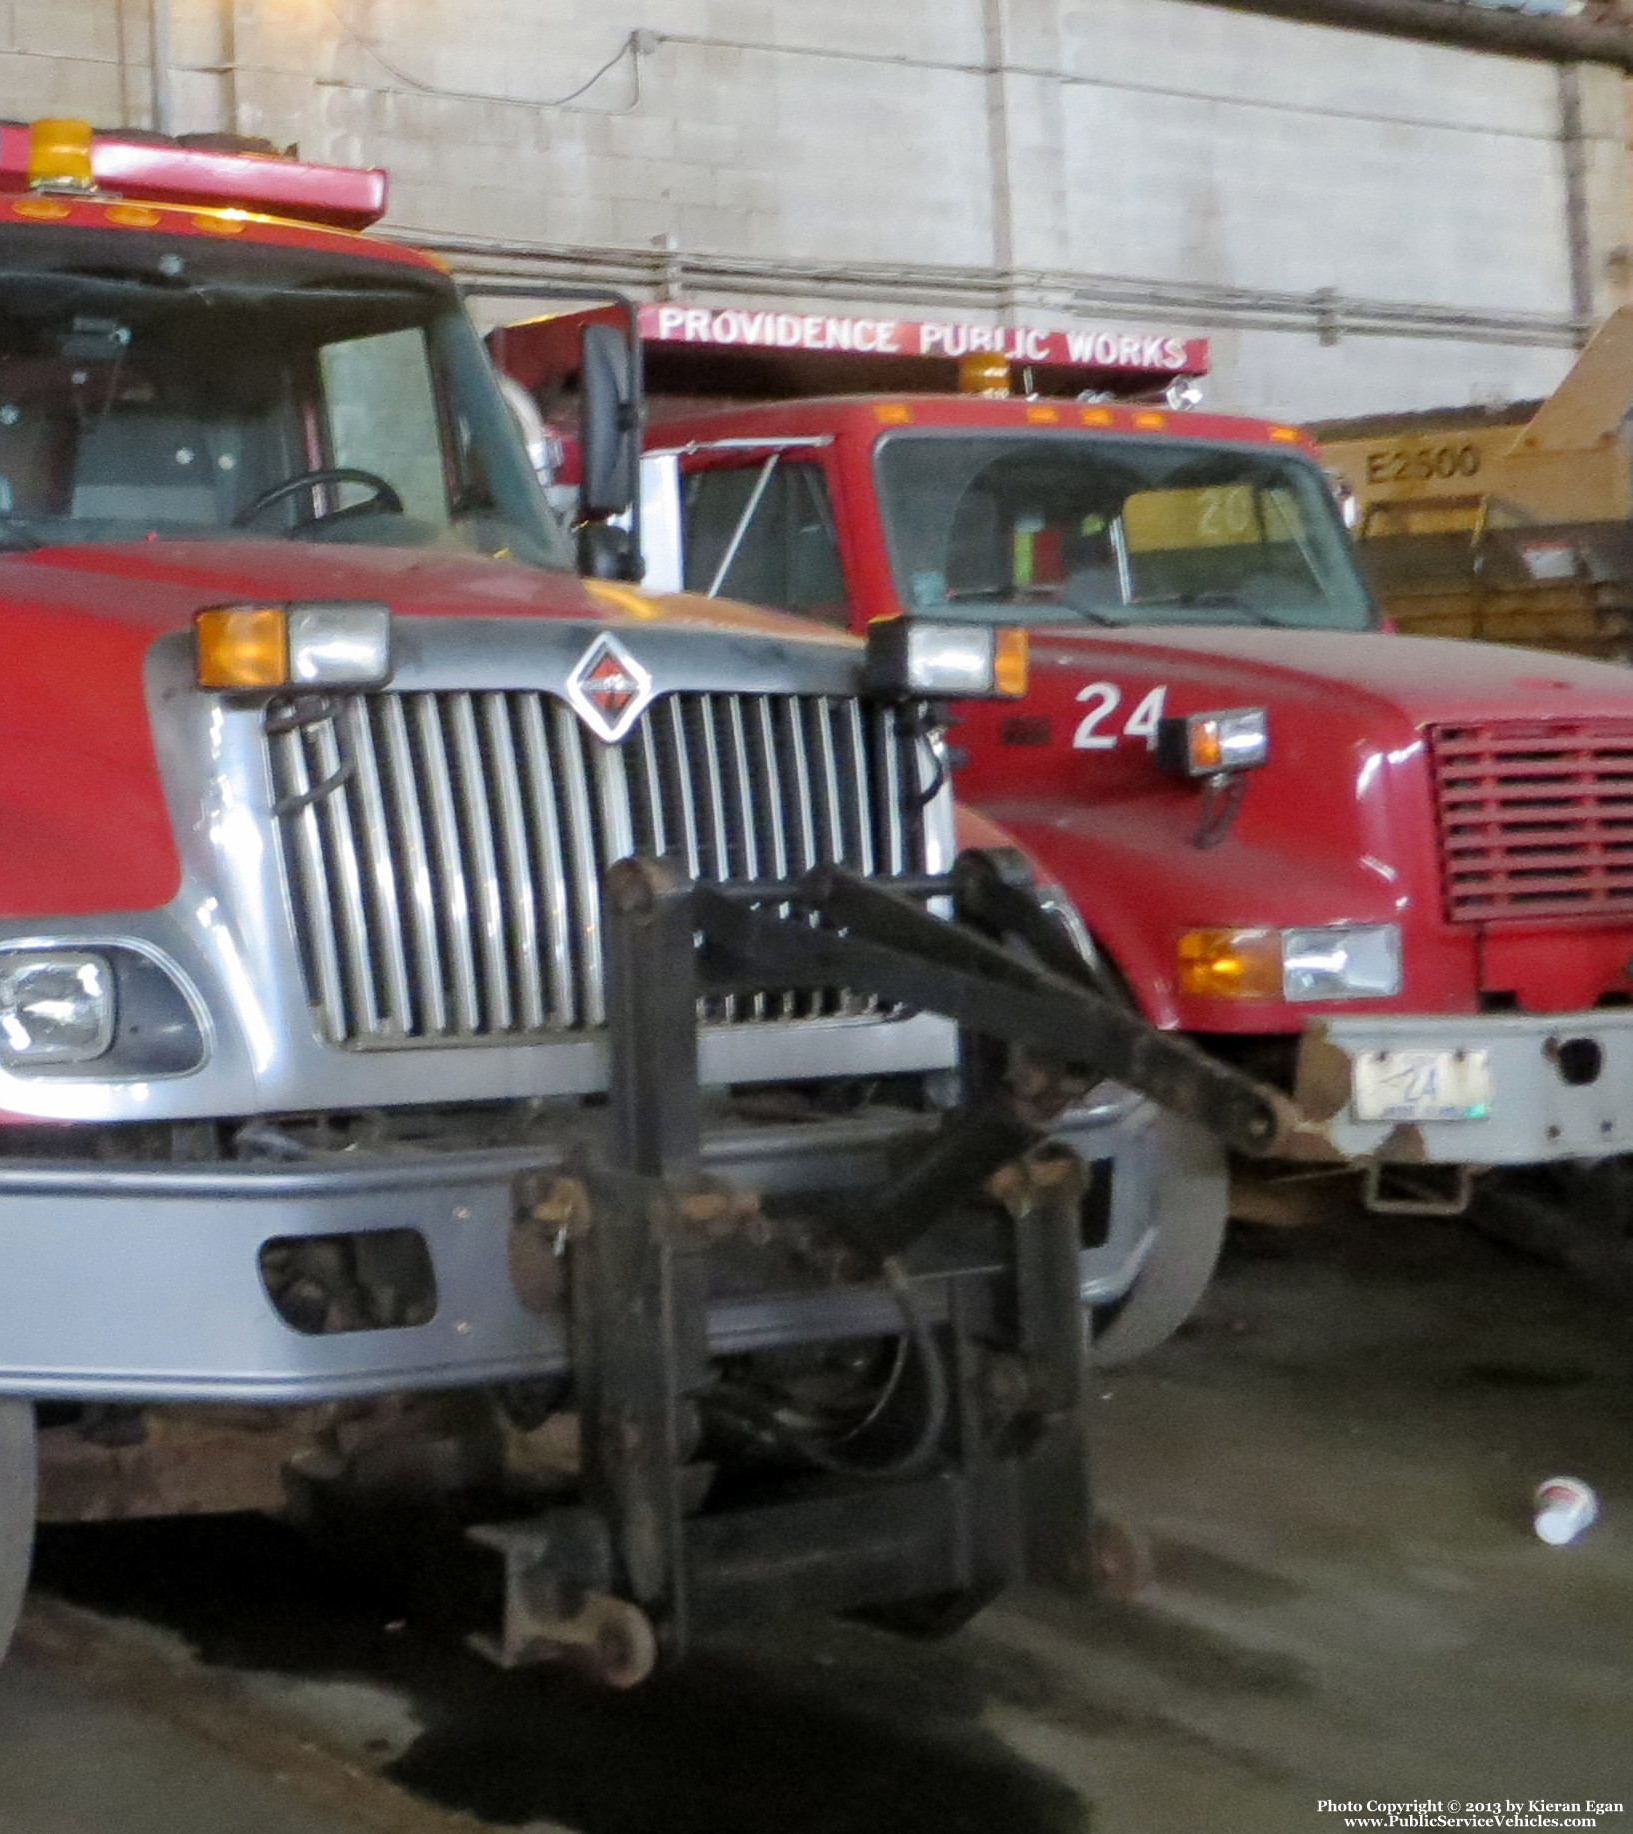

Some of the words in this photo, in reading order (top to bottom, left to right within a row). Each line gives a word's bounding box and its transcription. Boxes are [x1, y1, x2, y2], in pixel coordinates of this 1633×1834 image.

[659, 307, 899, 353] PROVIDENCE
[920, 323, 1050, 360] PUBLIC
[1067, 331, 1188, 370] WORKS
[1368, 446, 1481, 484] E2500
[1072, 681, 1168, 751] 24
